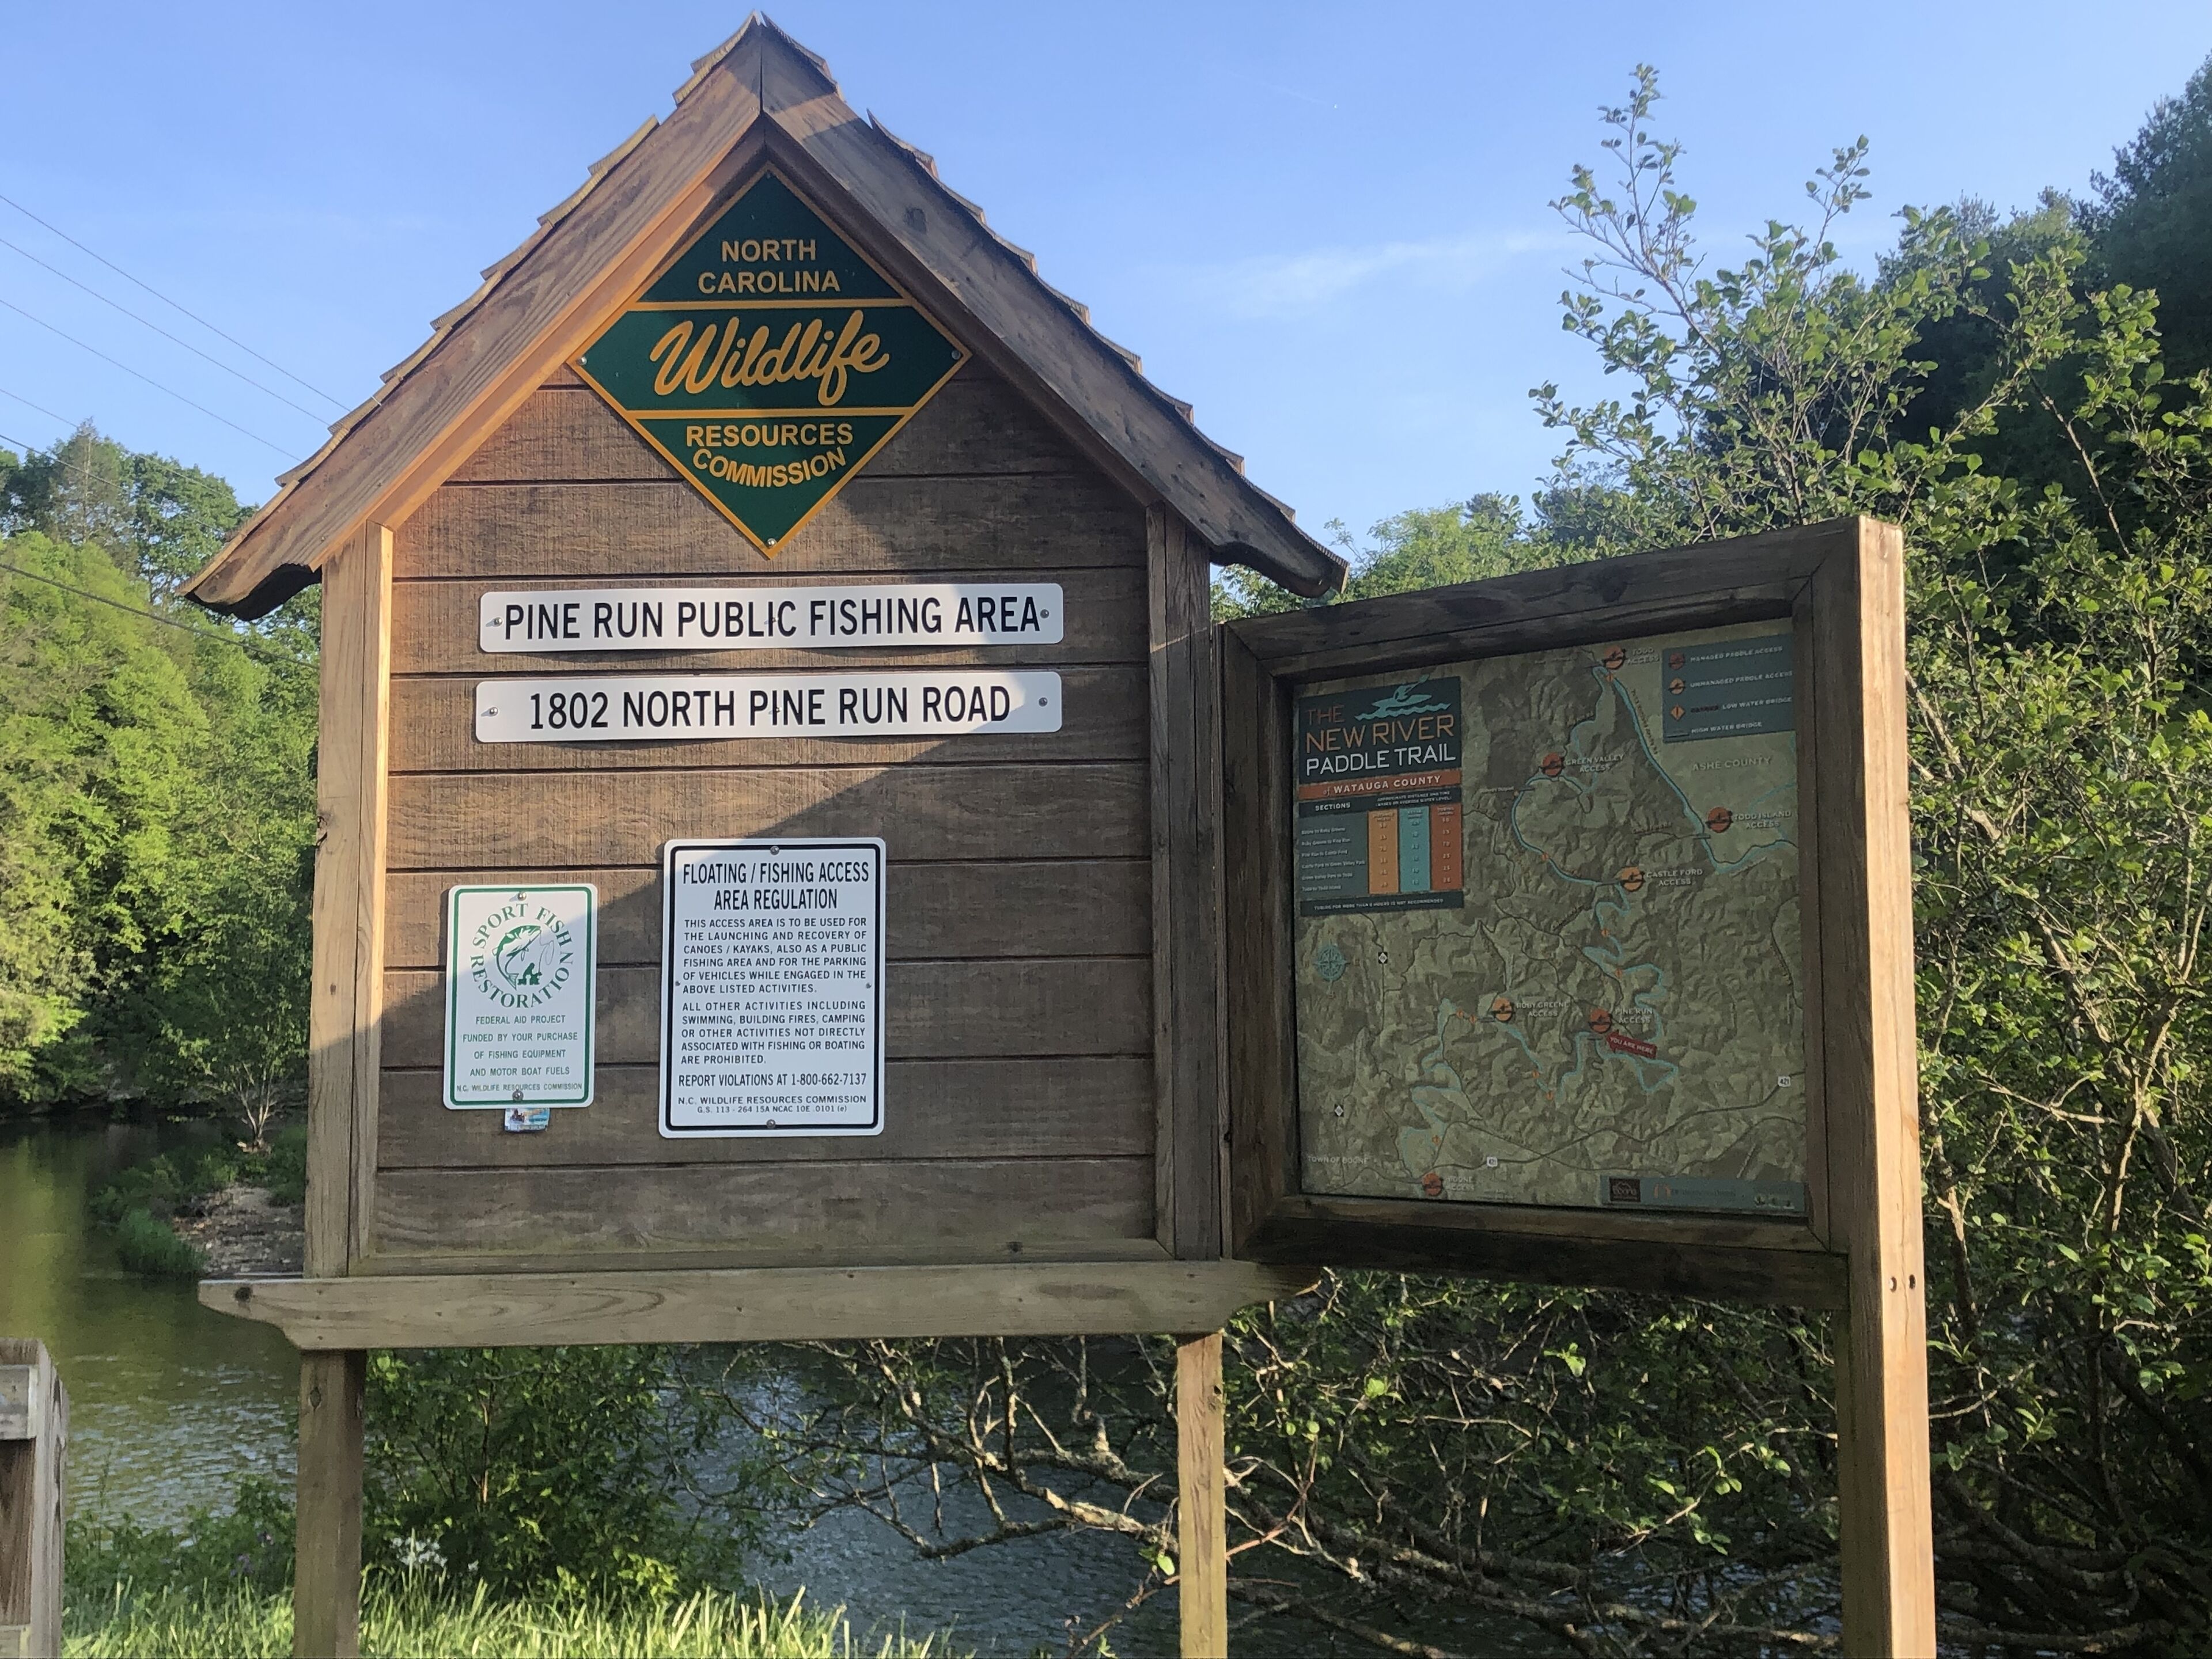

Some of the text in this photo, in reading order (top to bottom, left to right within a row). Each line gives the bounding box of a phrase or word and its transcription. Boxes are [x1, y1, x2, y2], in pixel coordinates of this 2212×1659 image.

[721, 238, 817, 262] NORTH
[698, 270, 840, 294] CAROLINA
[649, 309, 891, 407] Wildlife
[685, 422, 854, 448] RESOURCES
[692, 446, 847, 488] COMMISSION
[506, 597, 1039, 639] PINE RUN PUBLIC FISHING AREA
[531, 687, 1010, 729] 1802 NORTH PINE RUN ROAD
[1306, 704, 1345, 725] THE
[1306, 713, 1455, 753] NEW RIVER
[1306, 743, 1457, 776] PADDLE TRAIL
[1566, 754, 1624, 766] GREEN VALLEY
[1692, 755, 1772, 771] ASHE COUNTY
[1333, 780, 1389, 794] WATAUGA
[1393, 774, 1442, 788] COUNTY
[1315, 801, 1351, 812] SECTIONS
[683, 862, 869, 884] FLOATING / FISHING ACCESS
[1646, 868, 1703, 878] CASTLE FORD
[1658, 878, 1691, 887] ACCESS
[714, 889, 837, 910] AREA REGULATION
[472, 903, 573, 949] SPORT FISH
[684, 918, 866, 927] THIS ACCESS AREA IS TO BE USED FOR
[684, 933, 703, 941] THE
[709, 932, 768, 940] LAUNCHING
[798, 931, 850, 940] RECOVERY
[854, 931, 866, 939] OF
[684, 944, 866, 953] CANOES / KAYAKS, ALSO AS A PUBLIC
[684, 957, 866, 967] FISHING AREA AND FOR THE PARKING
[470, 952, 575, 1009] RESTORATION
[683, 971, 866, 980] OF VEHICLES WHILE ENGAGED IN THE
[683, 984, 816, 994] ABOVE LISTED ACTIVITIES.
[683, 1001, 865, 1011] ALL OTHER ACTIVITIES INCLUDING
[476, 1015, 566, 1024] FEDERAL AID PROJECT
[683, 1014, 865, 1024] SWIMMING, BUILDING FIRES, CAMPING
[463, 1032, 577, 1042] FUNDED BY YOUR PURCHASE
[681, 1028, 865, 1037] OR OTHER ACTIVITIES NOT DIRECTLY
[681, 1041, 865, 1051] ASSOCIATED WITH FISHING OR BOATING
[1623, 1040, 1636, 1049] ARE
[1636, 1044, 1654, 1054] HERE
[488, 1051, 518, 1059] FISHING
[522, 1050, 566, 1058] EQUIPMENT
[681, 1055, 766, 1064] ARE PROHIBITED.
[490, 1068, 517, 1076] MOTOR
[521, 1067, 541, 1075] BOAT
[679, 1073, 866, 1086] REPORT VIOLATIONS AT 1-800-662-7137
[503, 1084, 540, 1092] RESOURCES
[716, 1105, 730, 1113] 113
[737, 1105, 753, 1113] 264
[756, 1105, 770, 1113] 15A
[772, 1104, 793, 1113] NCAC
[796, 1104, 810, 1112] 10E
[837, 1104, 848, 1112] (e)
